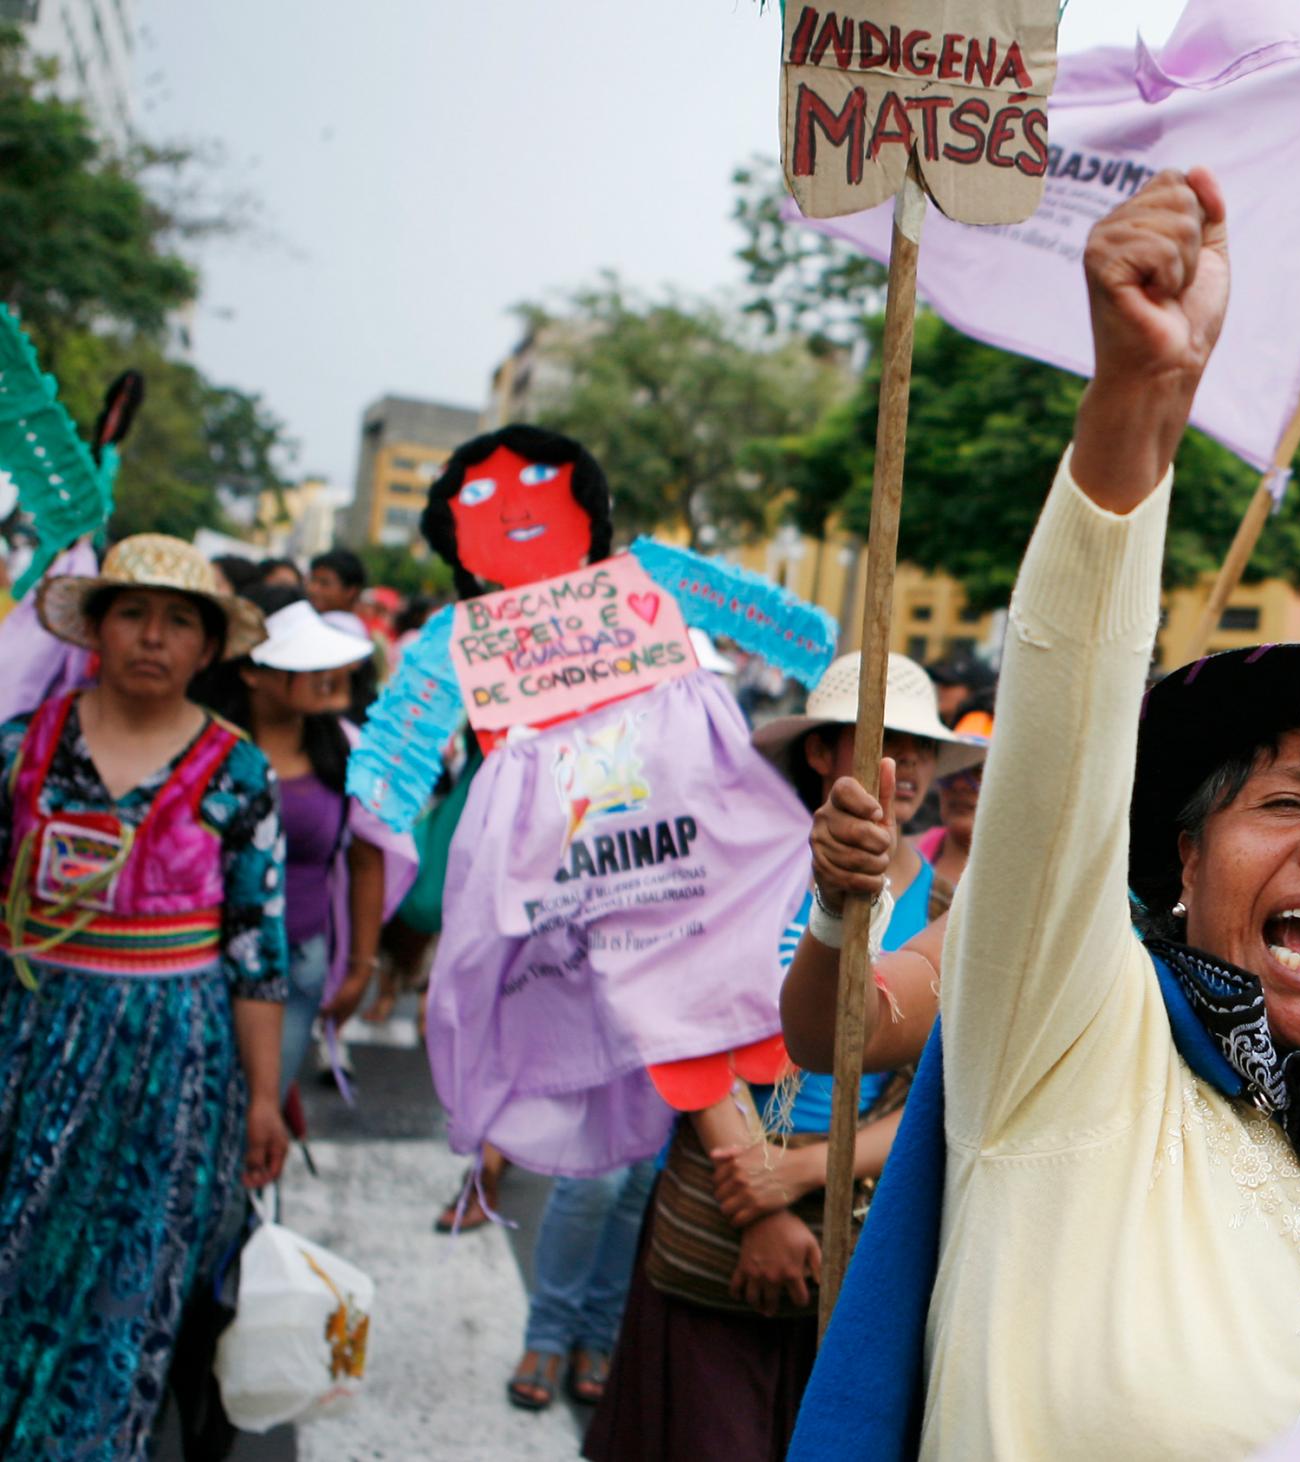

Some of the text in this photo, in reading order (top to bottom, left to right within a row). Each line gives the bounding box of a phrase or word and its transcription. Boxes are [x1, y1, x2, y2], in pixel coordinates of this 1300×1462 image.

[789, 6, 1032, 88] INDIGENA
[792, 82, 1048, 186] MATSÉS
[467, 571, 617, 631] BUSCAMOS
[600, 604, 619, 627] E
[472, 641, 686, 707] DE CONDICIONES
[504, 629, 636, 672] IGUALDAD
